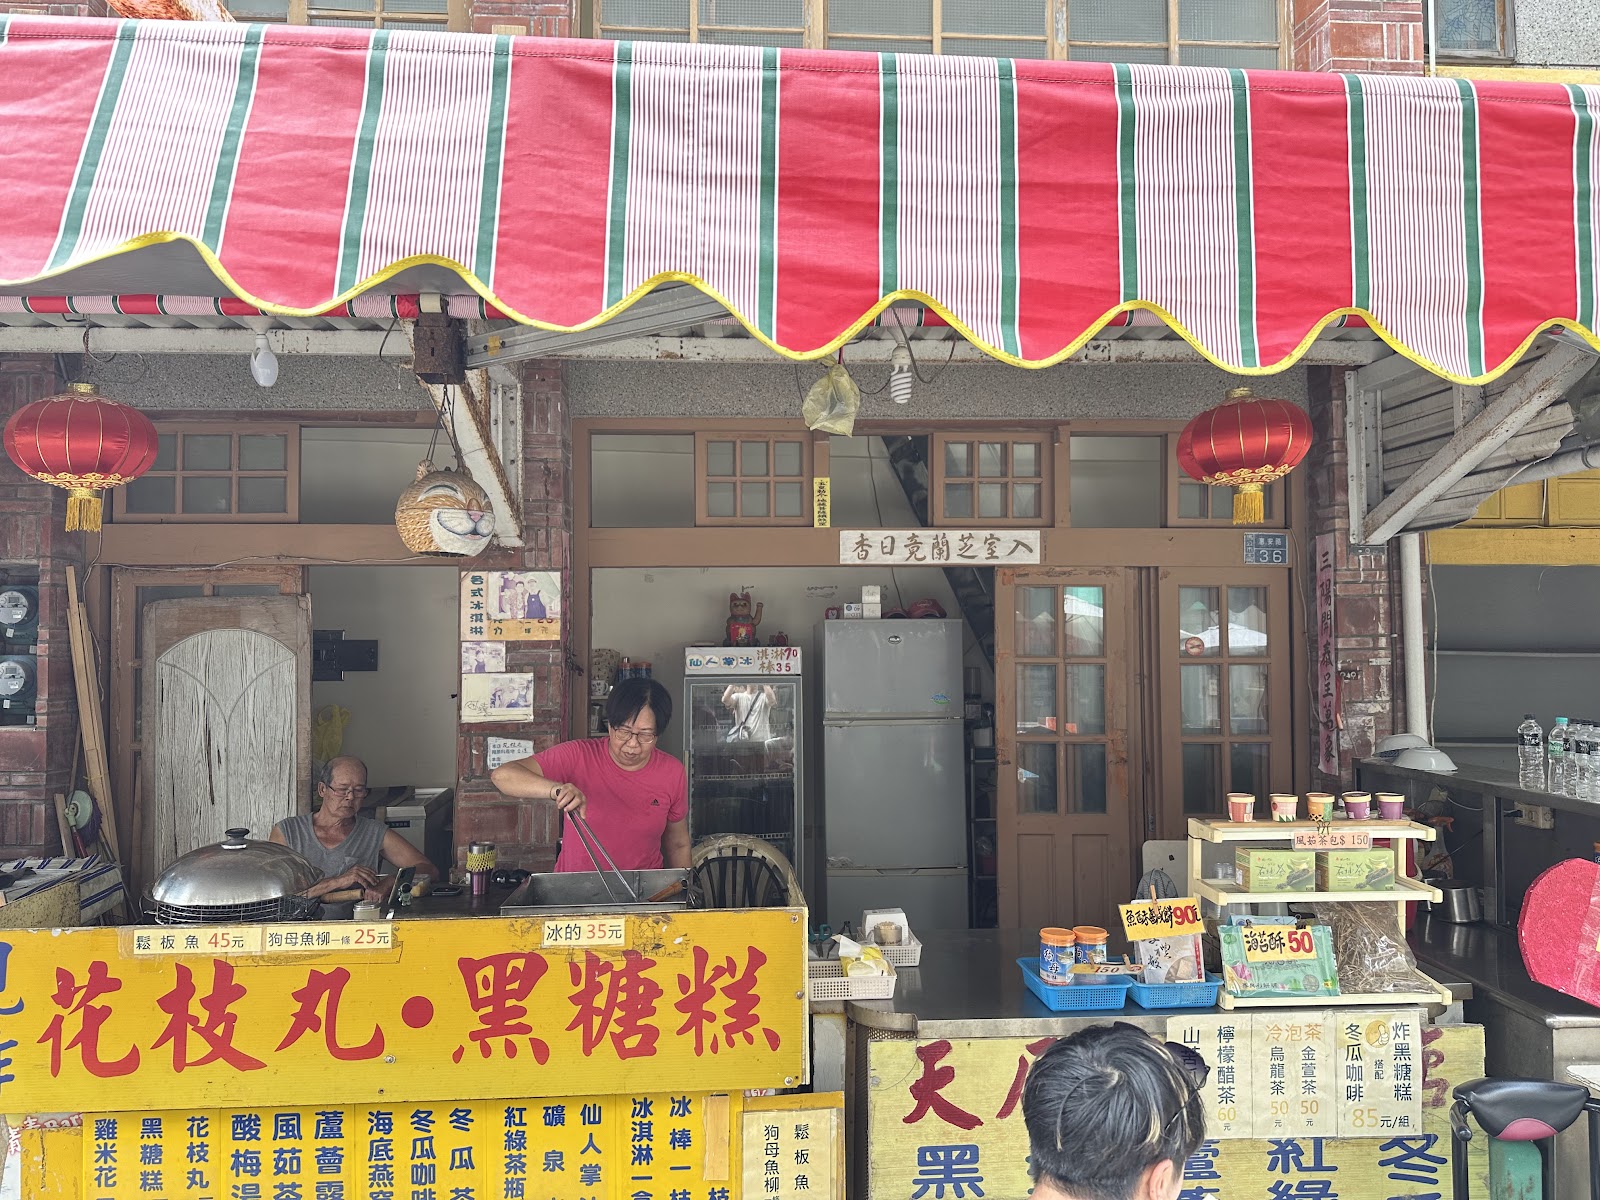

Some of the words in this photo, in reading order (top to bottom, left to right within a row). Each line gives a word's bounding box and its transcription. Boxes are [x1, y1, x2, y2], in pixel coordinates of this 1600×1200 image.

[1259, 549, 1282, 563] 36
[470, 575, 484, 635] 各式冰淇淋
[689, 656, 752, 667] 仙人掌冰
[776, 662, 791, 672] 35
[1351, 834, 1369, 846] 150
[136, 935, 199, 950] 鬆板魚
[208, 933, 244, 948] 45元
[354, 929, 389, 944] 25元
[546, 923, 581, 942] 冰的
[587, 923, 622, 939] 35元
[1244, 930, 1286, 954] 海苔酥
[1287, 930, 1314, 954] 50
[1265, 1023, 1322, 1042] 冷泡茶
[1216, 1025, 1236, 1105] 檸檬醋茶
[1301, 1045, 1316, 1095] 金萱茶
[1345, 1023, 1363, 1102] 冬瓜咖啡
[1374, 1059, 1384, 1080] 搭配
[1392, 1021, 1412, 1101] 炸黑糖糕
[1270, 1046, 1285, 1096] 烏龍茶
[1217, 1107, 1236, 1121] 60
[1270, 1100, 1289, 1115] 50
[1300, 1100, 1319, 1115] 50
[1223, 1123, 1231, 1131] 元
[1274, 1119, 1282, 1128] 元
[1305, 1118, 1314, 1127] 元
[139, 1117, 163, 1192] 黑糖糕
[186, 1116, 209, 1190] 花枝丸
[794, 1123, 810, 1191] 鬆板魚
